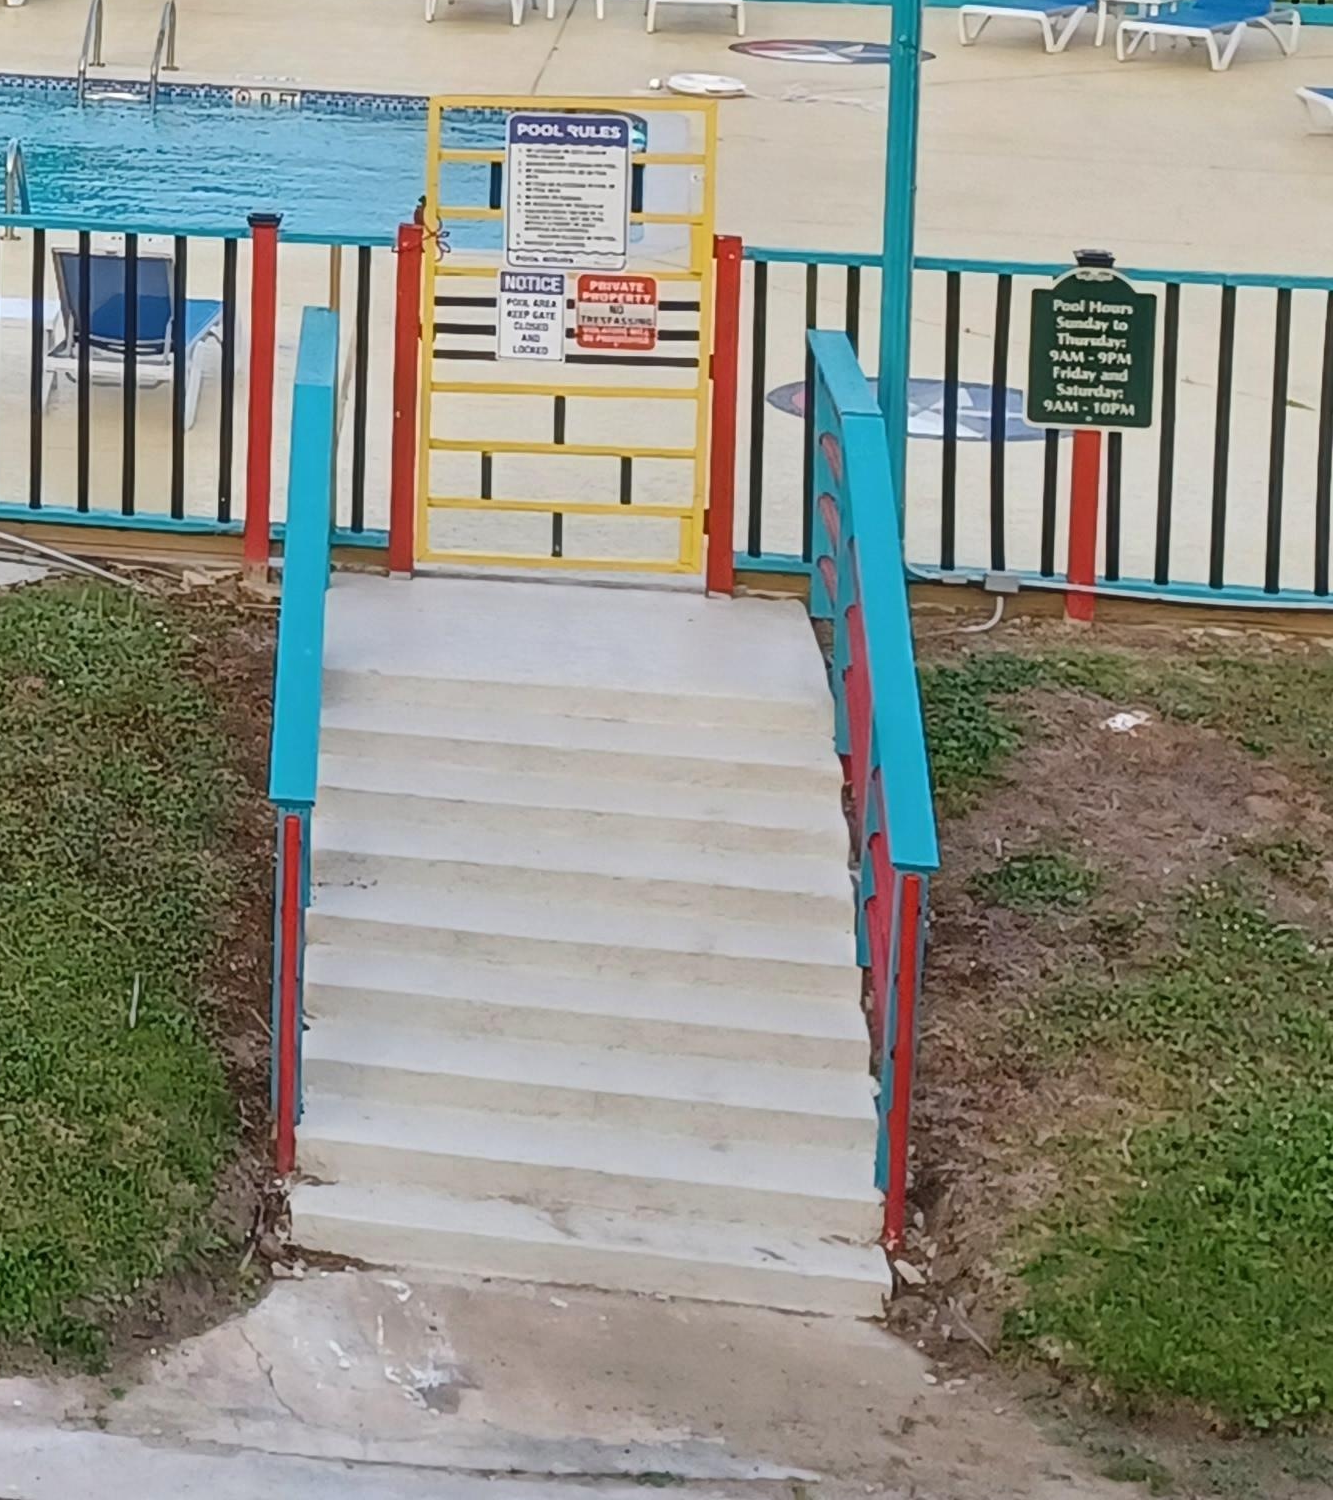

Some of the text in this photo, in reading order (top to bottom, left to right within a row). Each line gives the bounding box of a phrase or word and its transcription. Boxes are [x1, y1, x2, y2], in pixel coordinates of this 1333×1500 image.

[517, 123, 622, 139] POOL RULES
[504, 275, 562, 293] NOTICE
[589, 280, 646, 293] PRIVATE
[507, 298, 530, 308] POOL
[581, 291, 652, 304] PROPERTY
[609, 305, 625, 315] NO
[1053, 299, 1134, 315] Pool Hours
[506, 310, 557, 321] KEEP GATE
[580, 315, 654, 326] TRESPASSING
[513, 321, 549, 332] CLOSED
[1056, 316, 1129, 332] Sunday to
[521, 334, 541, 343] AND
[1056, 333, 1127, 350] Thursday:
[512, 345, 549, 356] LOCKED
[1049, 350, 1085, 363] 9AM
[1097, 351, 1132, 365] 9PM
[1053, 366, 1129, 383] Friday and
[1056, 383, 1124, 400] Saturday:
[1043, 399, 1079, 413] 9AM
[1093, 402, 1135, 417] 10PM
